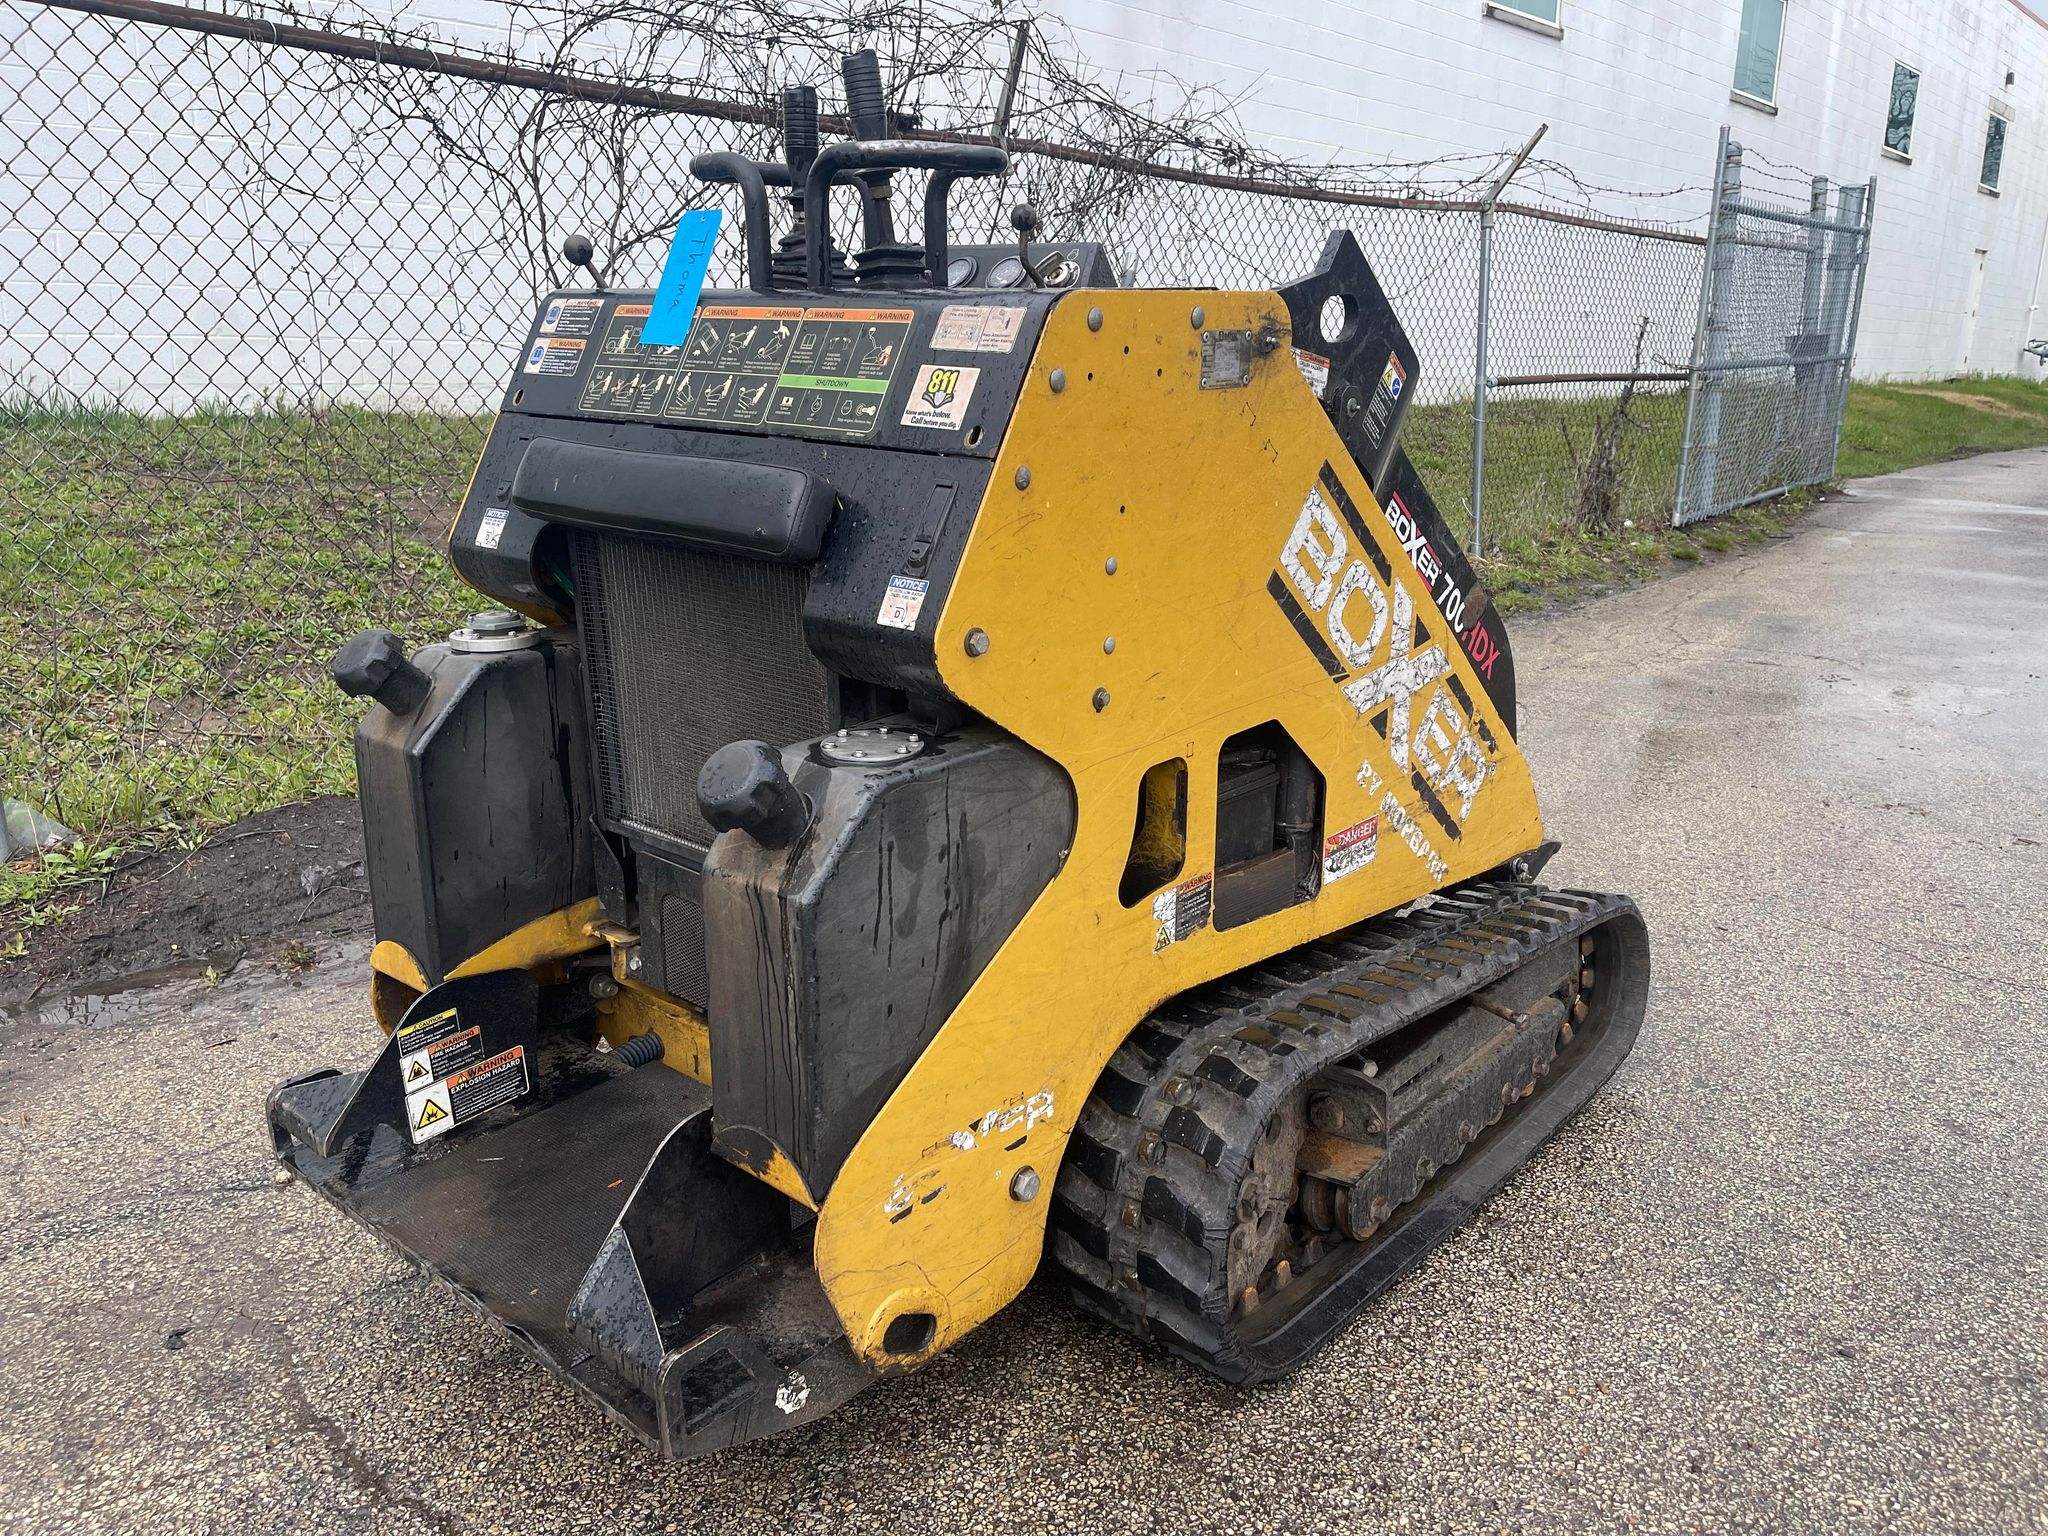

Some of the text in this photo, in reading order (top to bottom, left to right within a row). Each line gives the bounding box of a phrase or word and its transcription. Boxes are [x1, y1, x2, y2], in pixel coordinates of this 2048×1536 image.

[771, 310, 801, 318] WARNING
[814, 311, 845, 319] WARNING
[876, 312, 910, 321] WARNING
[815, 379, 850, 388] SHUTDOWN
[927, 368, 960, 394] 811
[911, 416, 924, 425] Call
[1385, 498, 1441, 587] BOXER
[892, 578, 925, 591] NOTICE
[1279, 485, 1487, 823] BOXER
[1185, 872, 1212, 891] WARNING
[418, 1014, 444, 1029] CAUTION
[441, 1030, 475, 1048] WARNING
[431, 1040, 468, 1060] FIRE HAZARD
[467, 1051, 514, 1078] WARNING
[450, 1058, 521, 1094] EXPLOSION HAZARD
